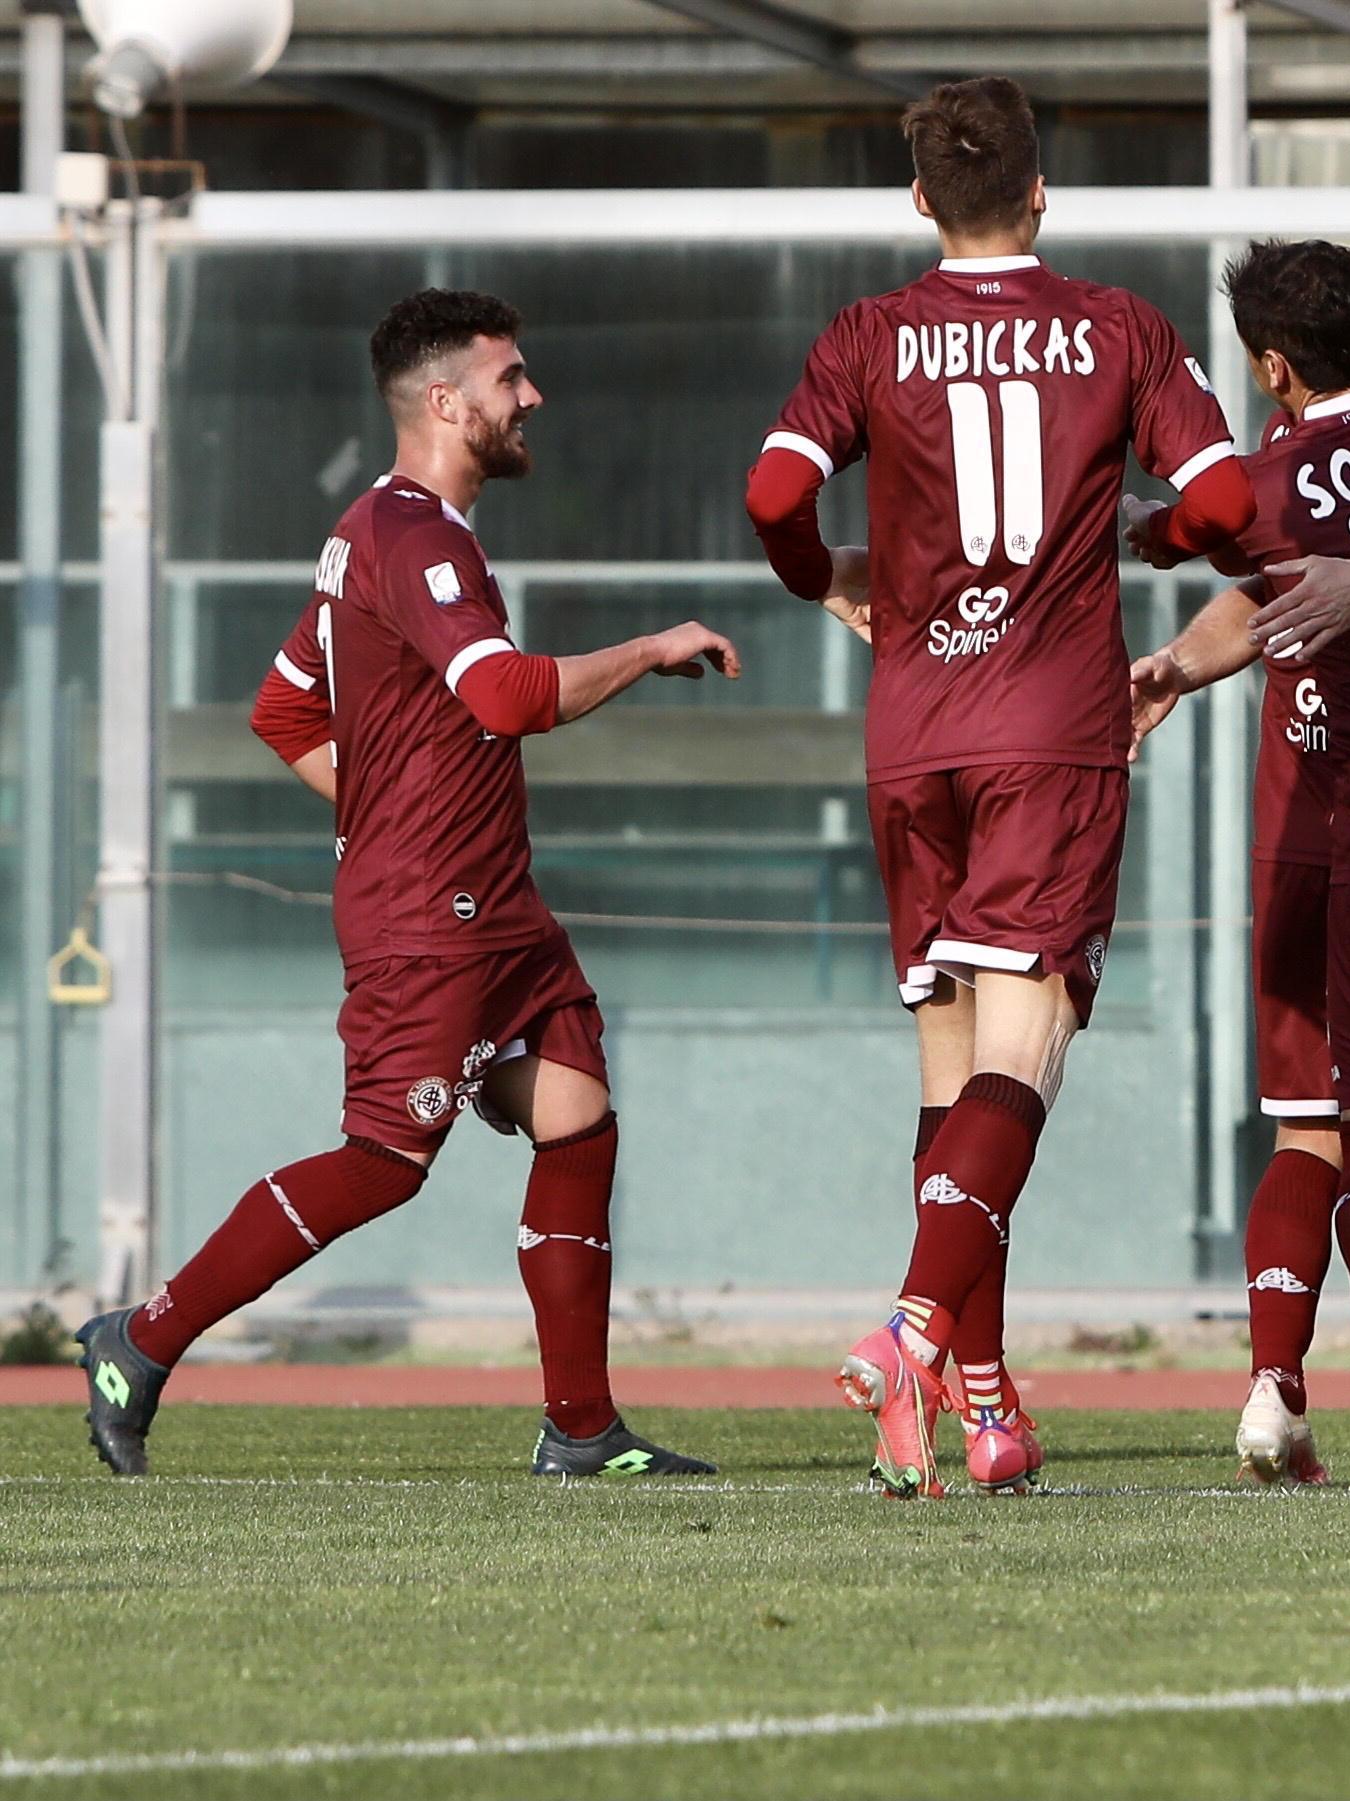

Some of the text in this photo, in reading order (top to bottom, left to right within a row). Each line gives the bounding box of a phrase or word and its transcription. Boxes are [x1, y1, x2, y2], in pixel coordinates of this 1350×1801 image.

[976, 282, 1001, 295] 1915
[897, 316, 1095, 383] DUBICKAS
[947, 380, 1044, 567] 11
[958, 586, 1009, 623] GO
